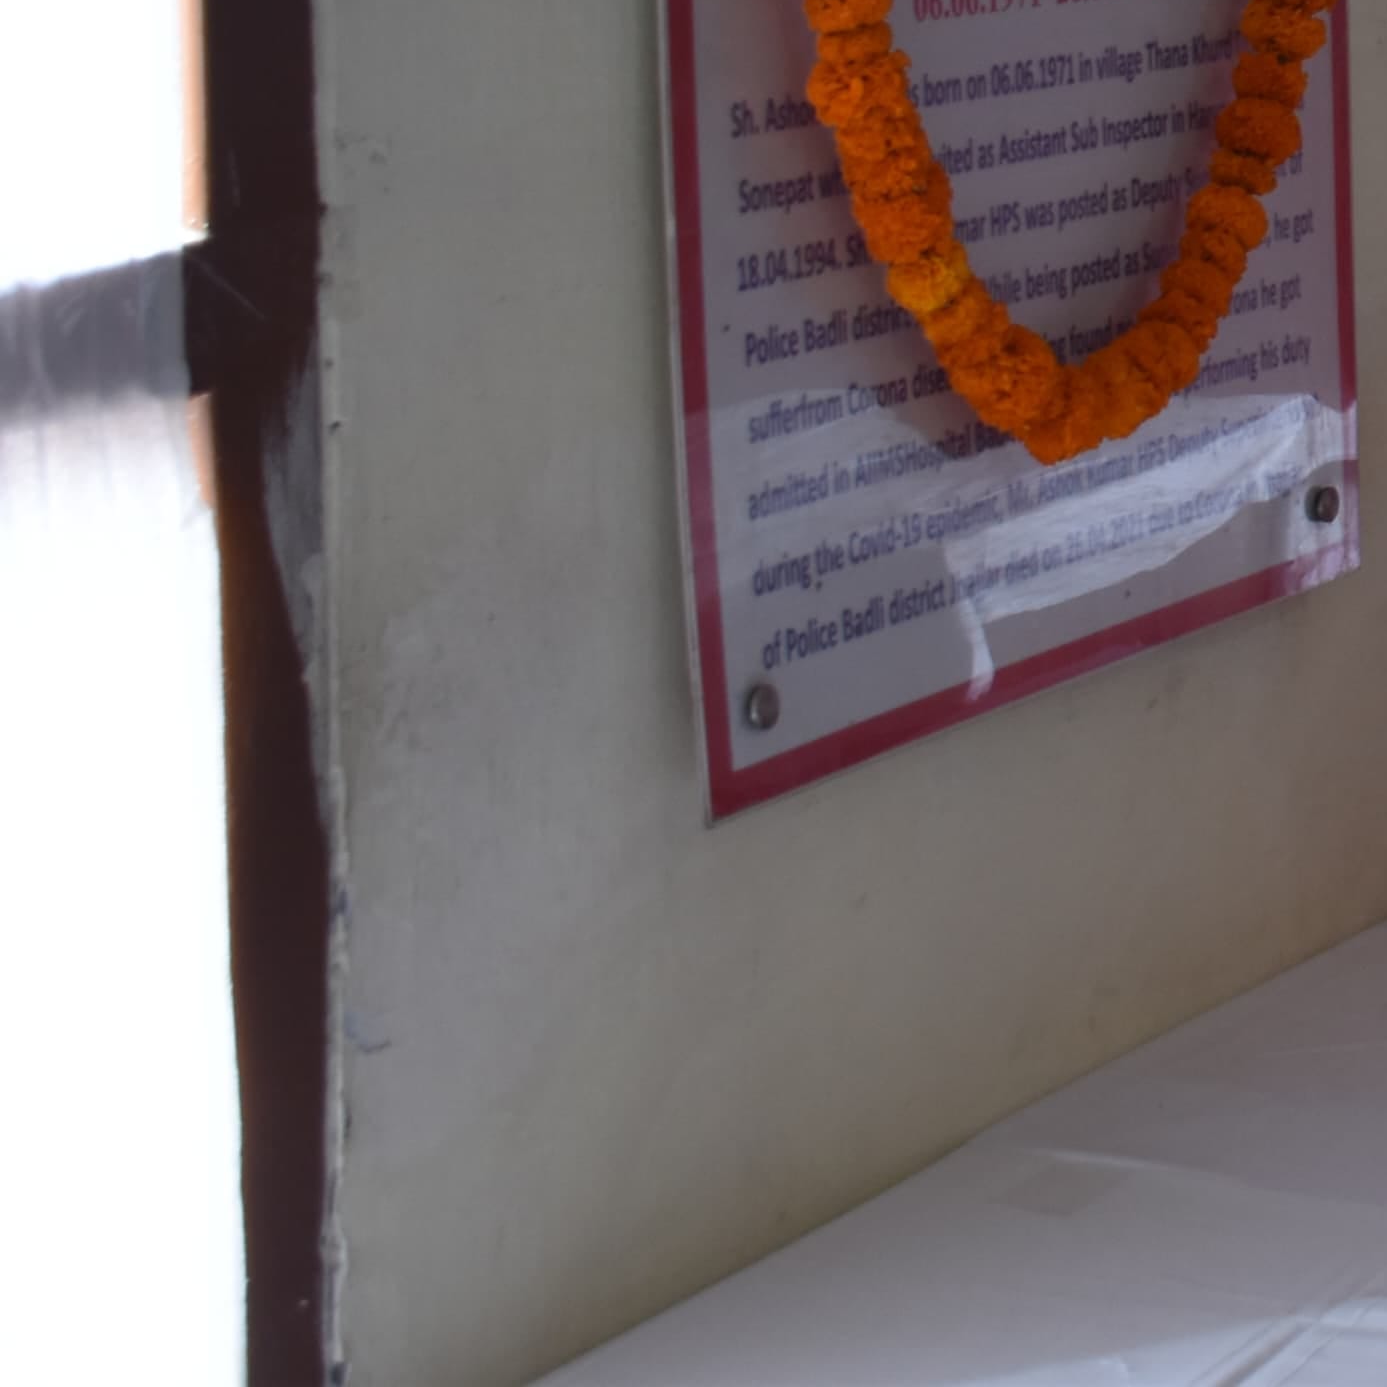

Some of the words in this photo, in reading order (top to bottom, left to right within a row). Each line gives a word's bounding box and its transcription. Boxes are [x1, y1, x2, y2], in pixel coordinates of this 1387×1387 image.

[730, 100, 760, 139] Sh.
[765, 94, 818, 133] Asho
[923, 72, 963, 107] born
[967, 73, 988, 101] on
[990, 55, 1076, 97] 06.06.1971
[1078, 51, 1094, 83] in
[1096, 44, 1144, 82] village
[1145, 40, 1189, 72] Thana
[738, 170, 814, 215] Sonepat
[978, 143, 996, 167] as
[999, 127, 1068, 165] Assistant
[1070, 117, 1098, 153] Sub
[1101, 108, 1168, 151] Inspector
[1172, 104, 1186, 134] in
[990, 201, 1021, 237] HPS
[1025, 202, 1054, 230] was
[1057, 181, 1108, 232] posted
[1111, 185, 1128, 212] as
[1131, 171, 1182, 210] Deputy
[745, 324, 800, 369] Police
[802, 308, 848, 353] Badli
[1025, 262, 1068, 300] being
[1070, 251, 1121, 298] posted
[1123, 250, 1142, 277] as
[1273, 212, 1290, 242] he
[1293, 207, 1314, 244] got
[846, 375, 908, 416] Corona
[1260, 278, 1277, 307] he
[1279, 271, 1302, 311] got
[747, 463, 829, 521] admitted
[832, 460, 851, 495] in
[1261, 338, 1279, 372] his
[1281, 333, 1312, 367] duty
[752, 551, 812, 597] during
[814, 537, 846, 577] the
[847, 512, 923, 565] Covid-19
[761, 628, 781, 671] of
[785, 617, 839, 663] Police
[841, 594, 885, 643] Badli
[888, 573, 947, 627] district
